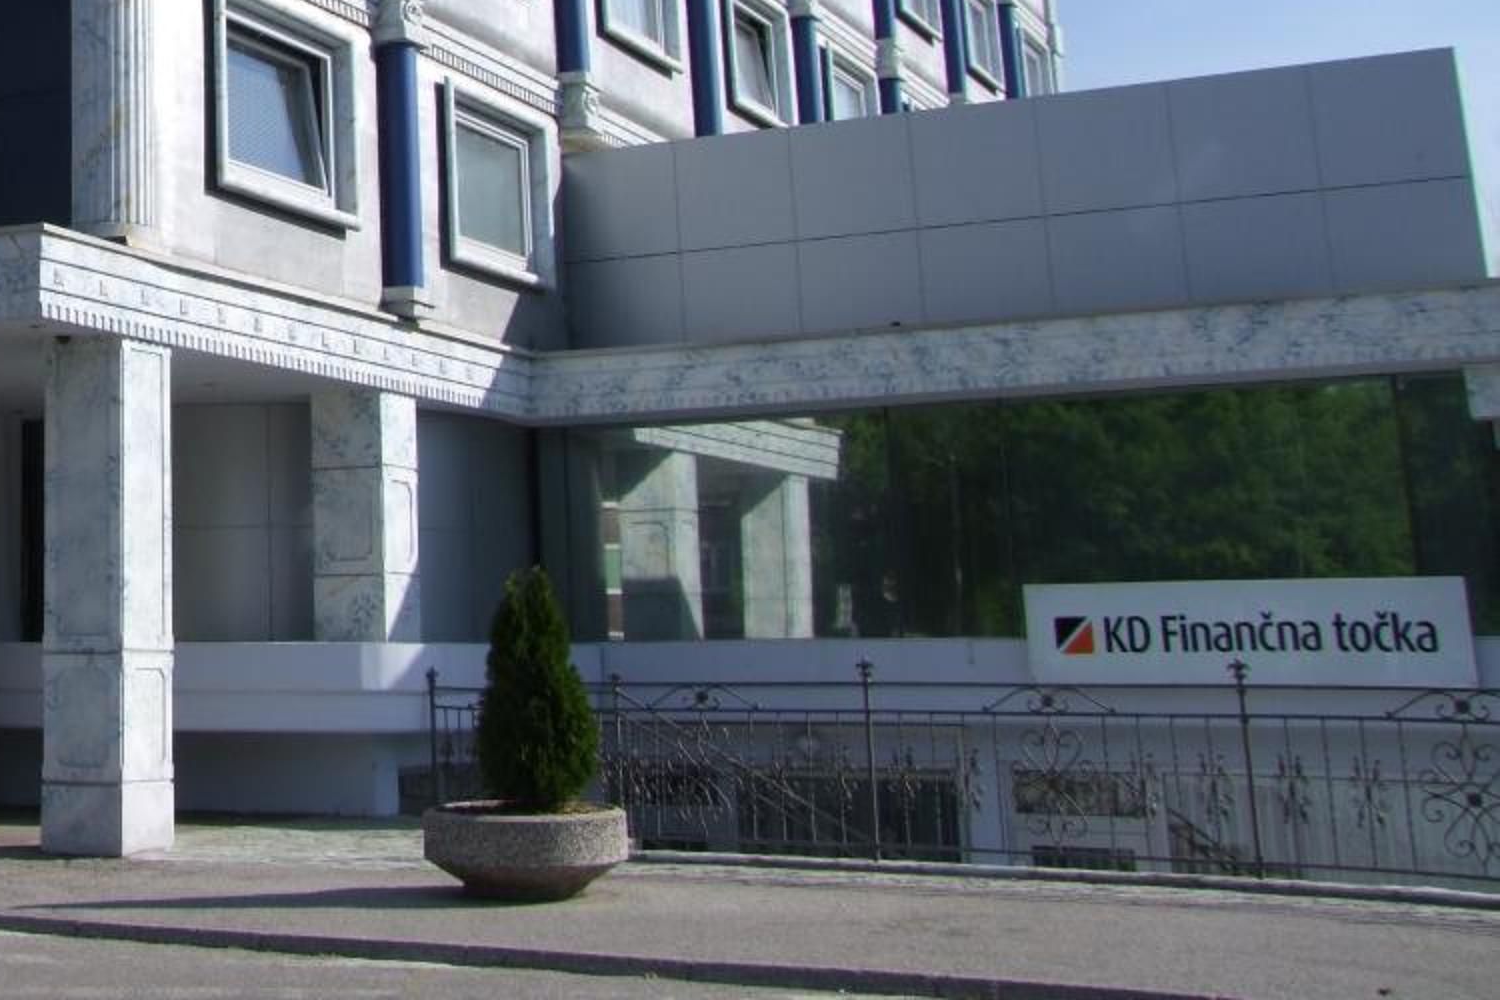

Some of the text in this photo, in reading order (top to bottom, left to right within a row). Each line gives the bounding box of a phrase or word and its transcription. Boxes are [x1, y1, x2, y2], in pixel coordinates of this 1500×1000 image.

[1104, 611, 1439, 653] KD Finančna točka
